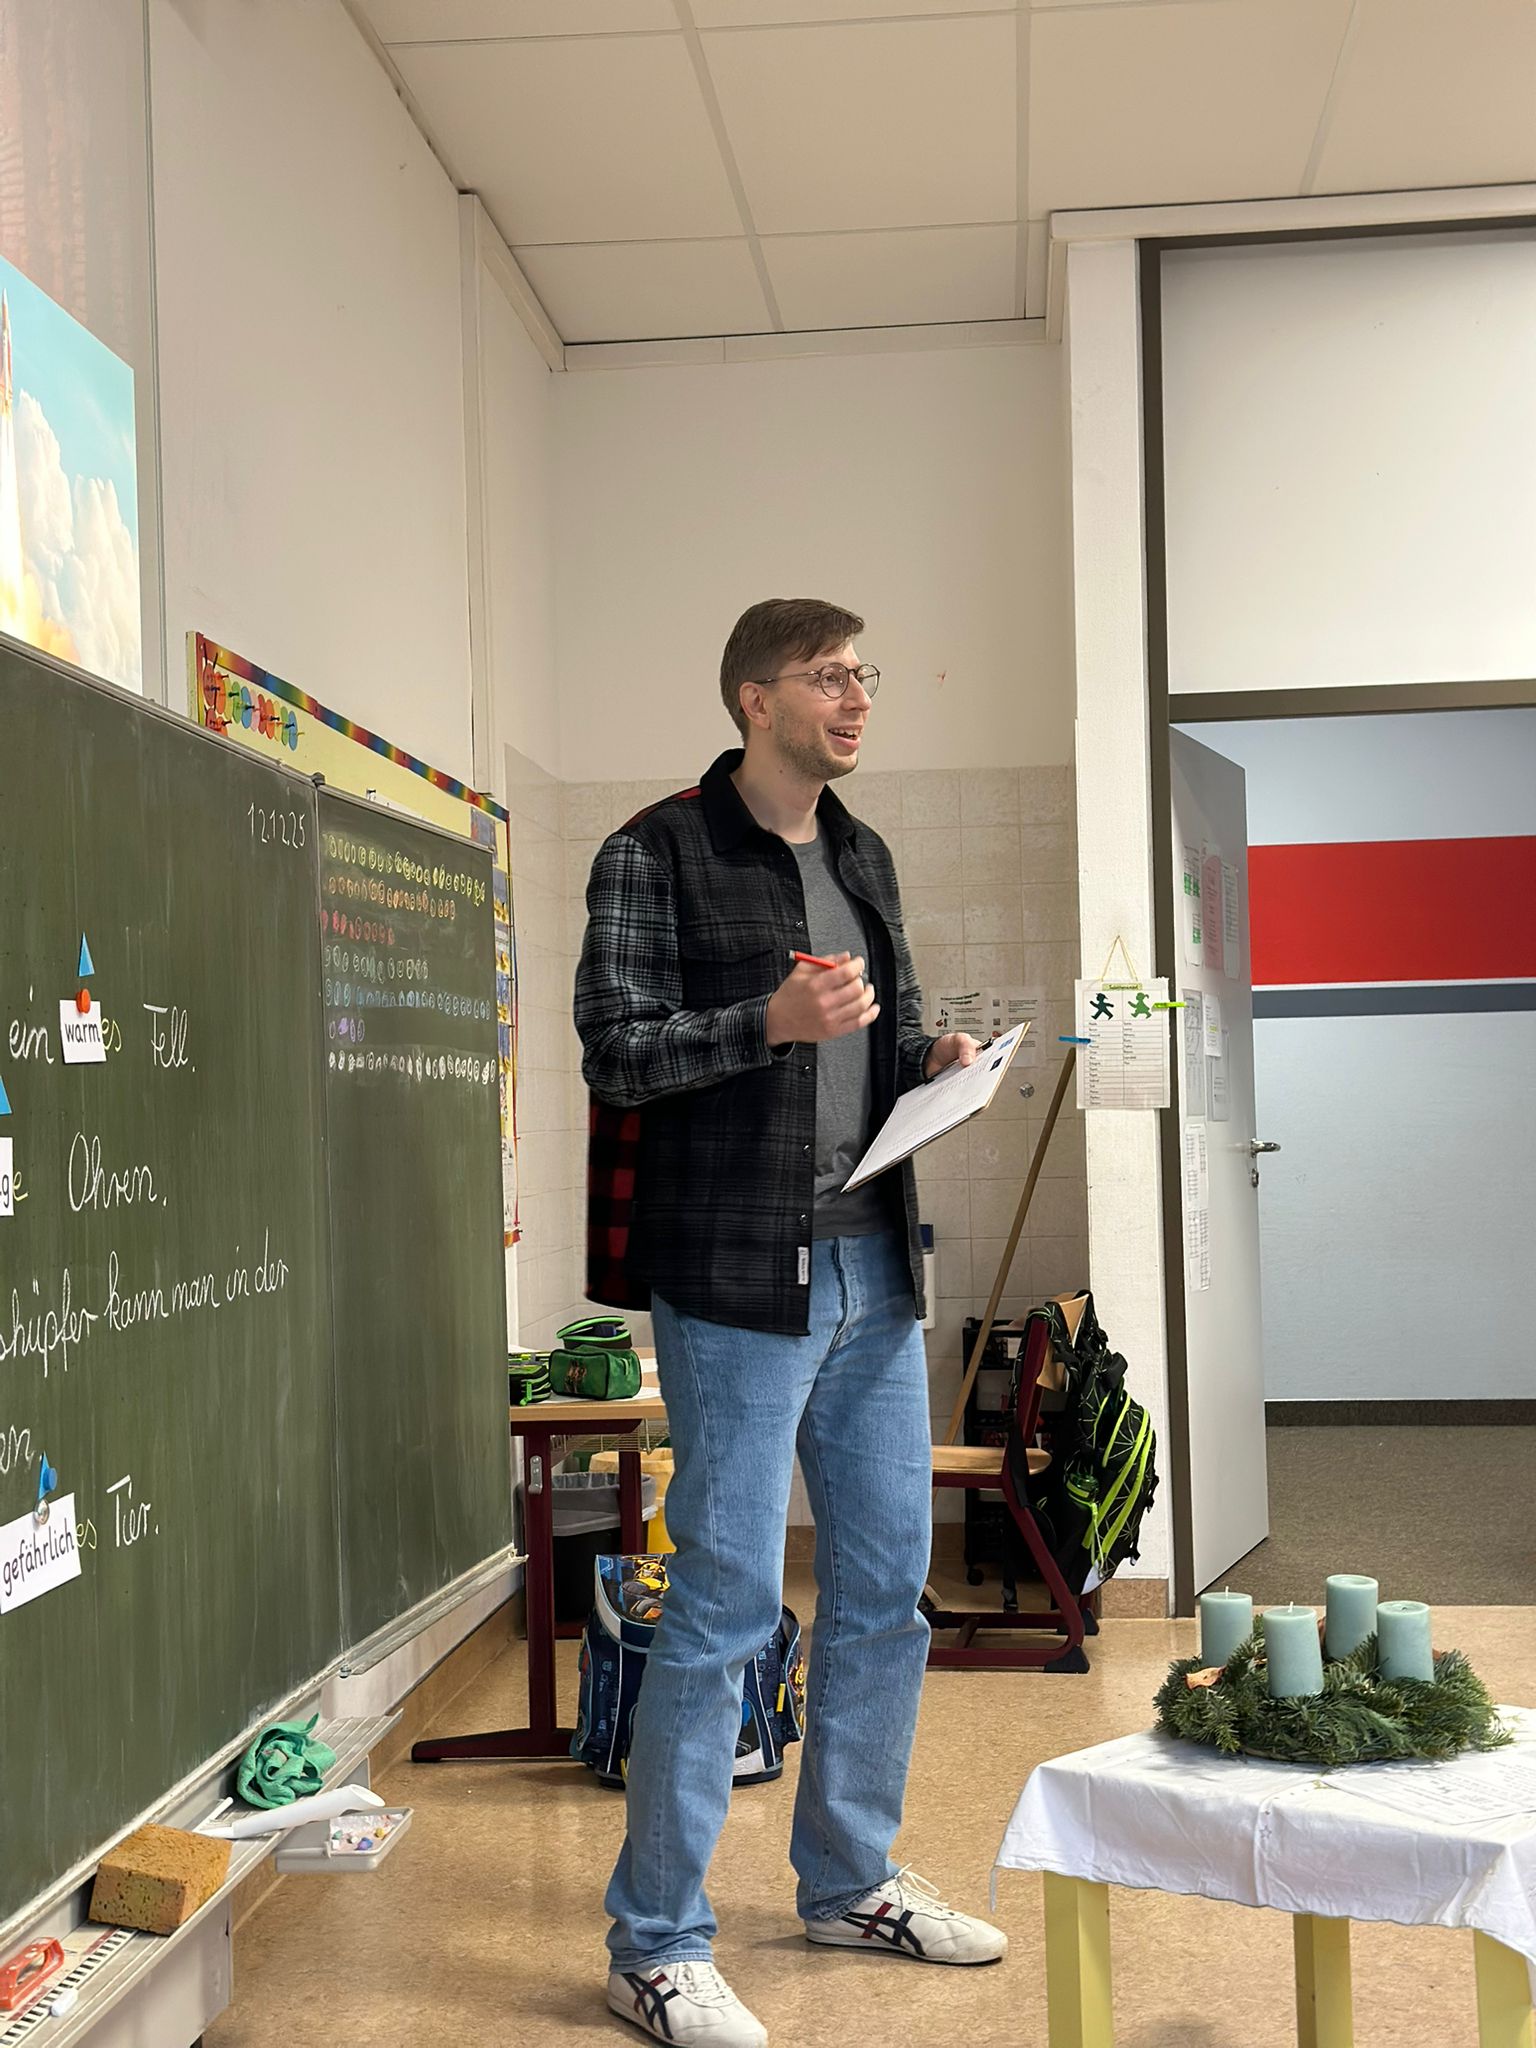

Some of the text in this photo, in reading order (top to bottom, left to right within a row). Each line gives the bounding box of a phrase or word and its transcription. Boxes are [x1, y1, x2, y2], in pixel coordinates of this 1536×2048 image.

[9, 984, 55, 1065] ein
[0, 1131, 167, 1212] ge Ohren.
[103, 1250, 170, 1331] kann
[171, 1273, 221, 1314] man
[226, 1245, 250, 1302] in
[254, 1225, 289, 1293] der
[106, 1474, 159, 1548] Tier.
